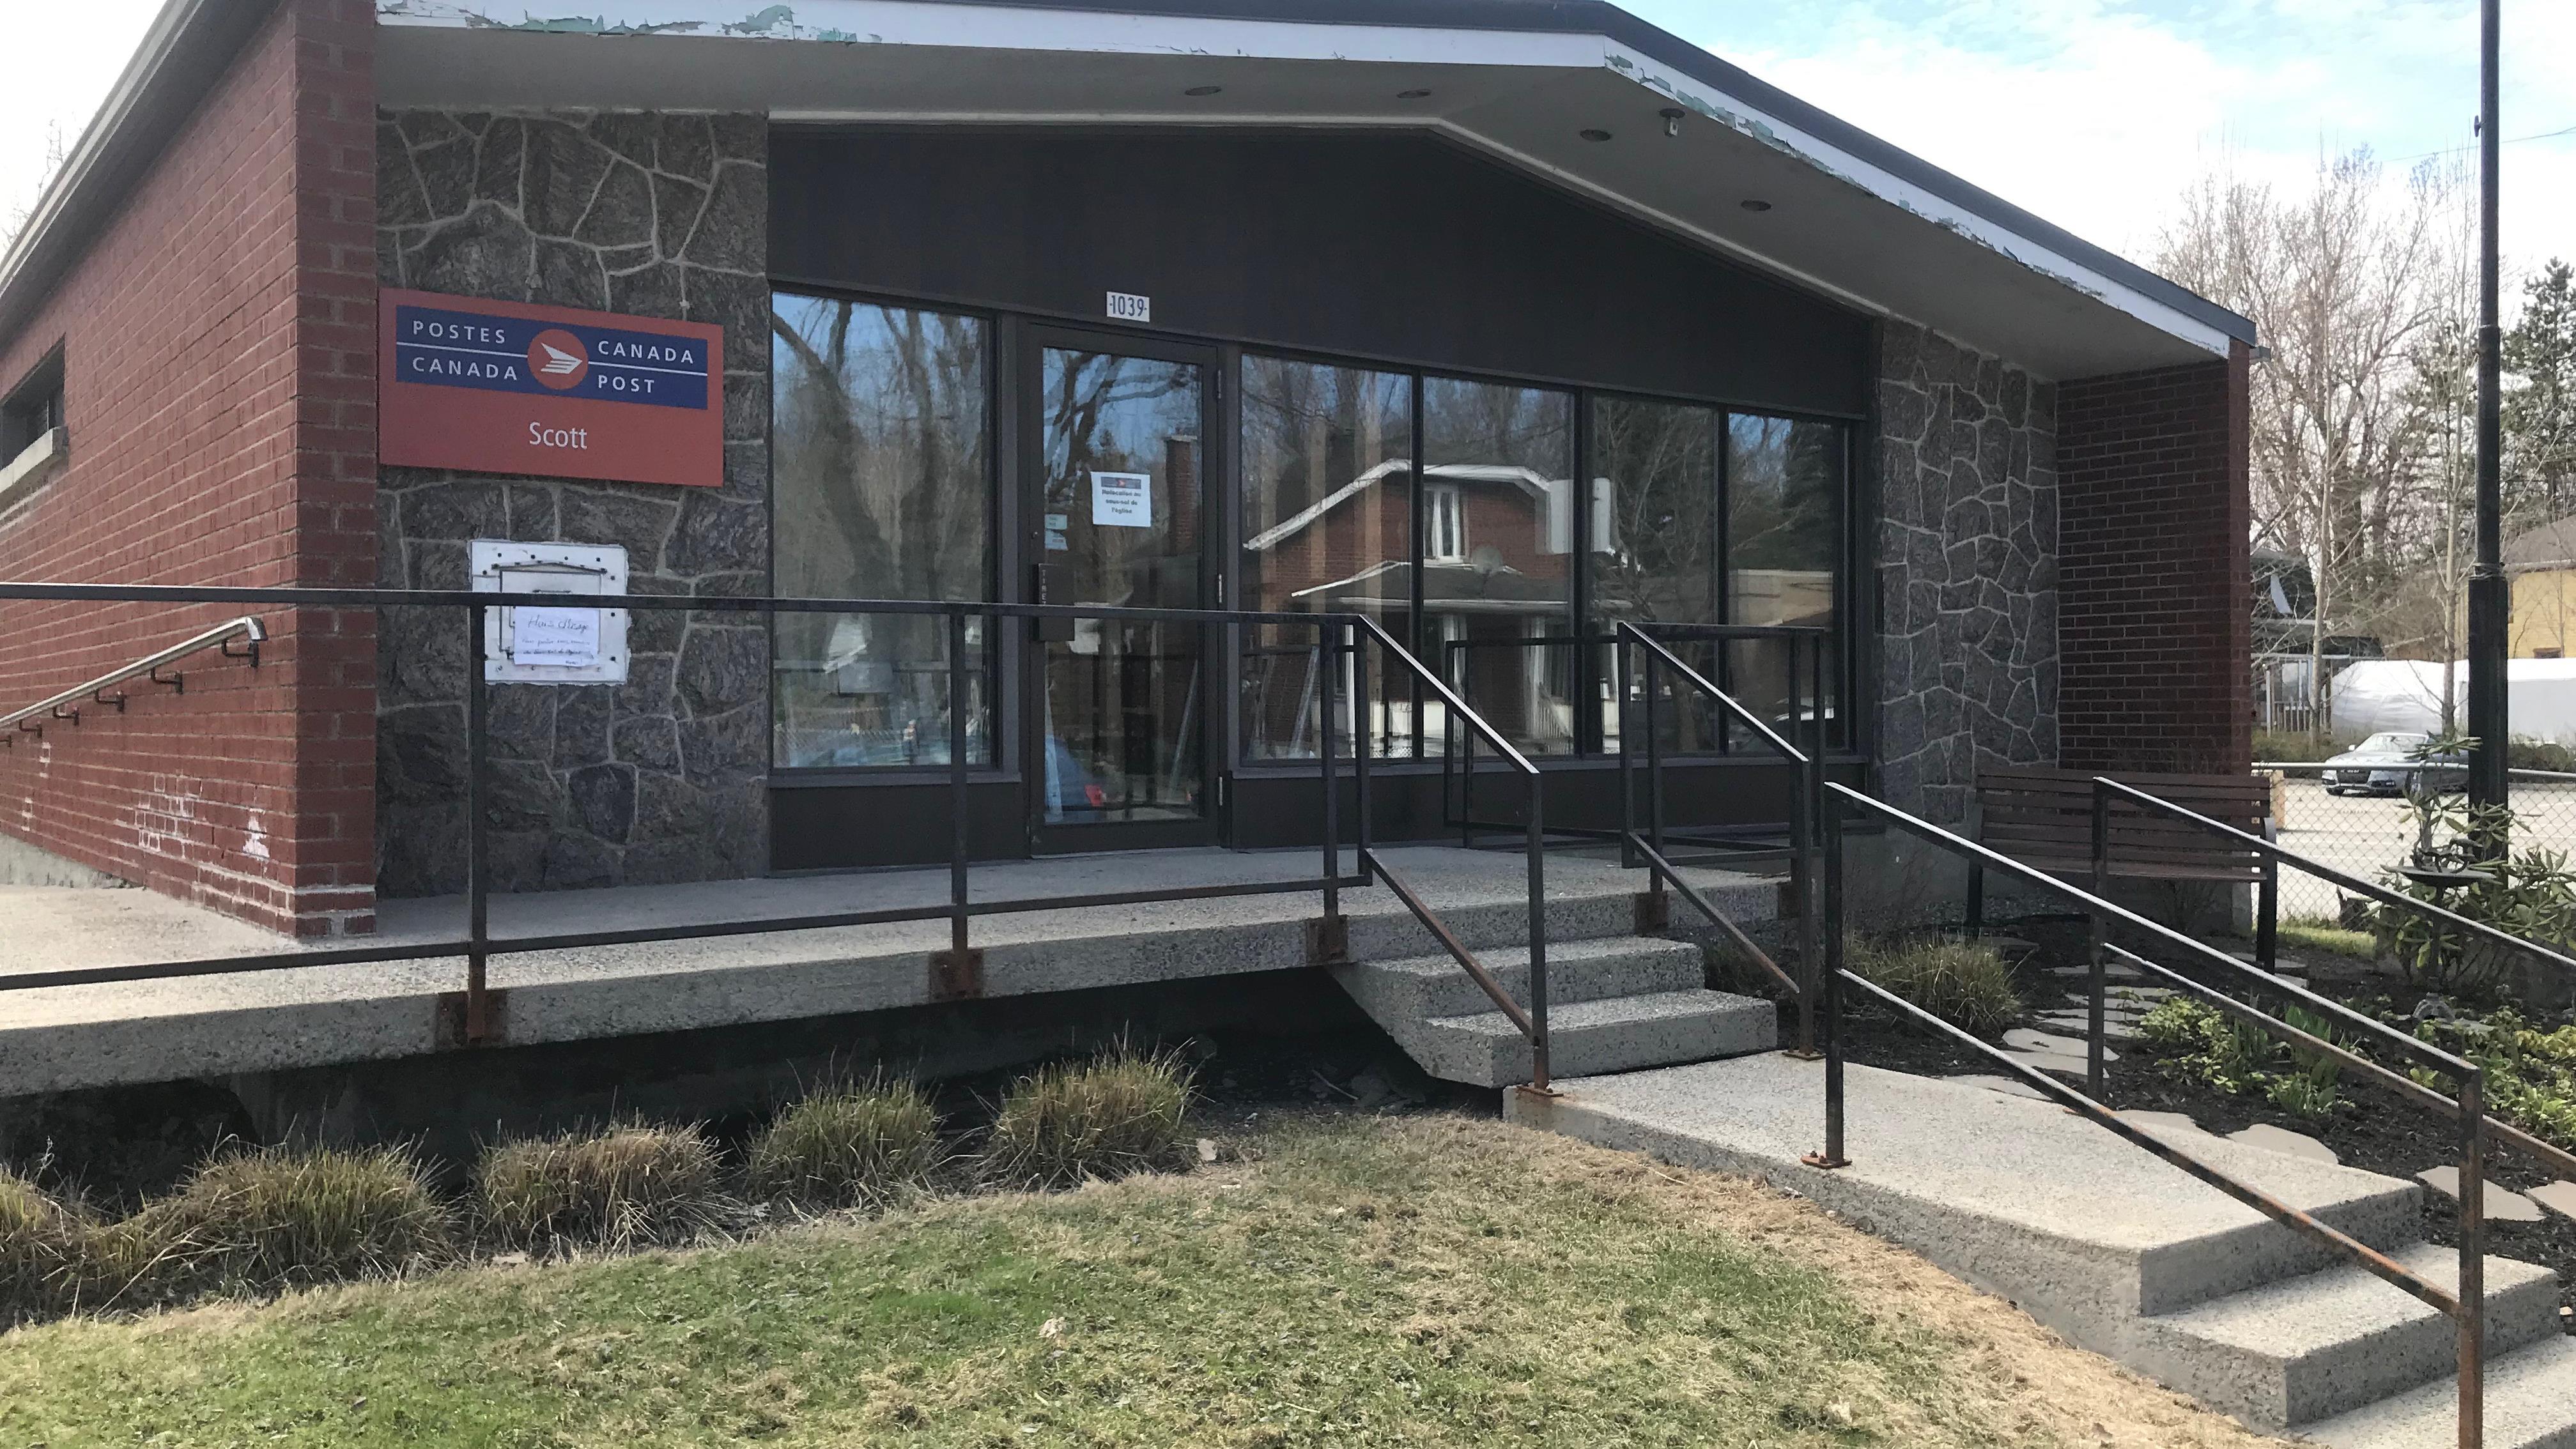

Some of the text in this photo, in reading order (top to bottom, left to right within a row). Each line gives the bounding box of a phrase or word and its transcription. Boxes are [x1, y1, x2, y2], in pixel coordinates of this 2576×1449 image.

[1111, 295, 1144, 316] 1039
[412, 320, 505, 344] POSTES
[598, 340, 694, 364] CANADA
[412, 356, 518, 381] CANADA
[598, 375, 655, 394] POST
[528, 422, 588, 449] Scott
